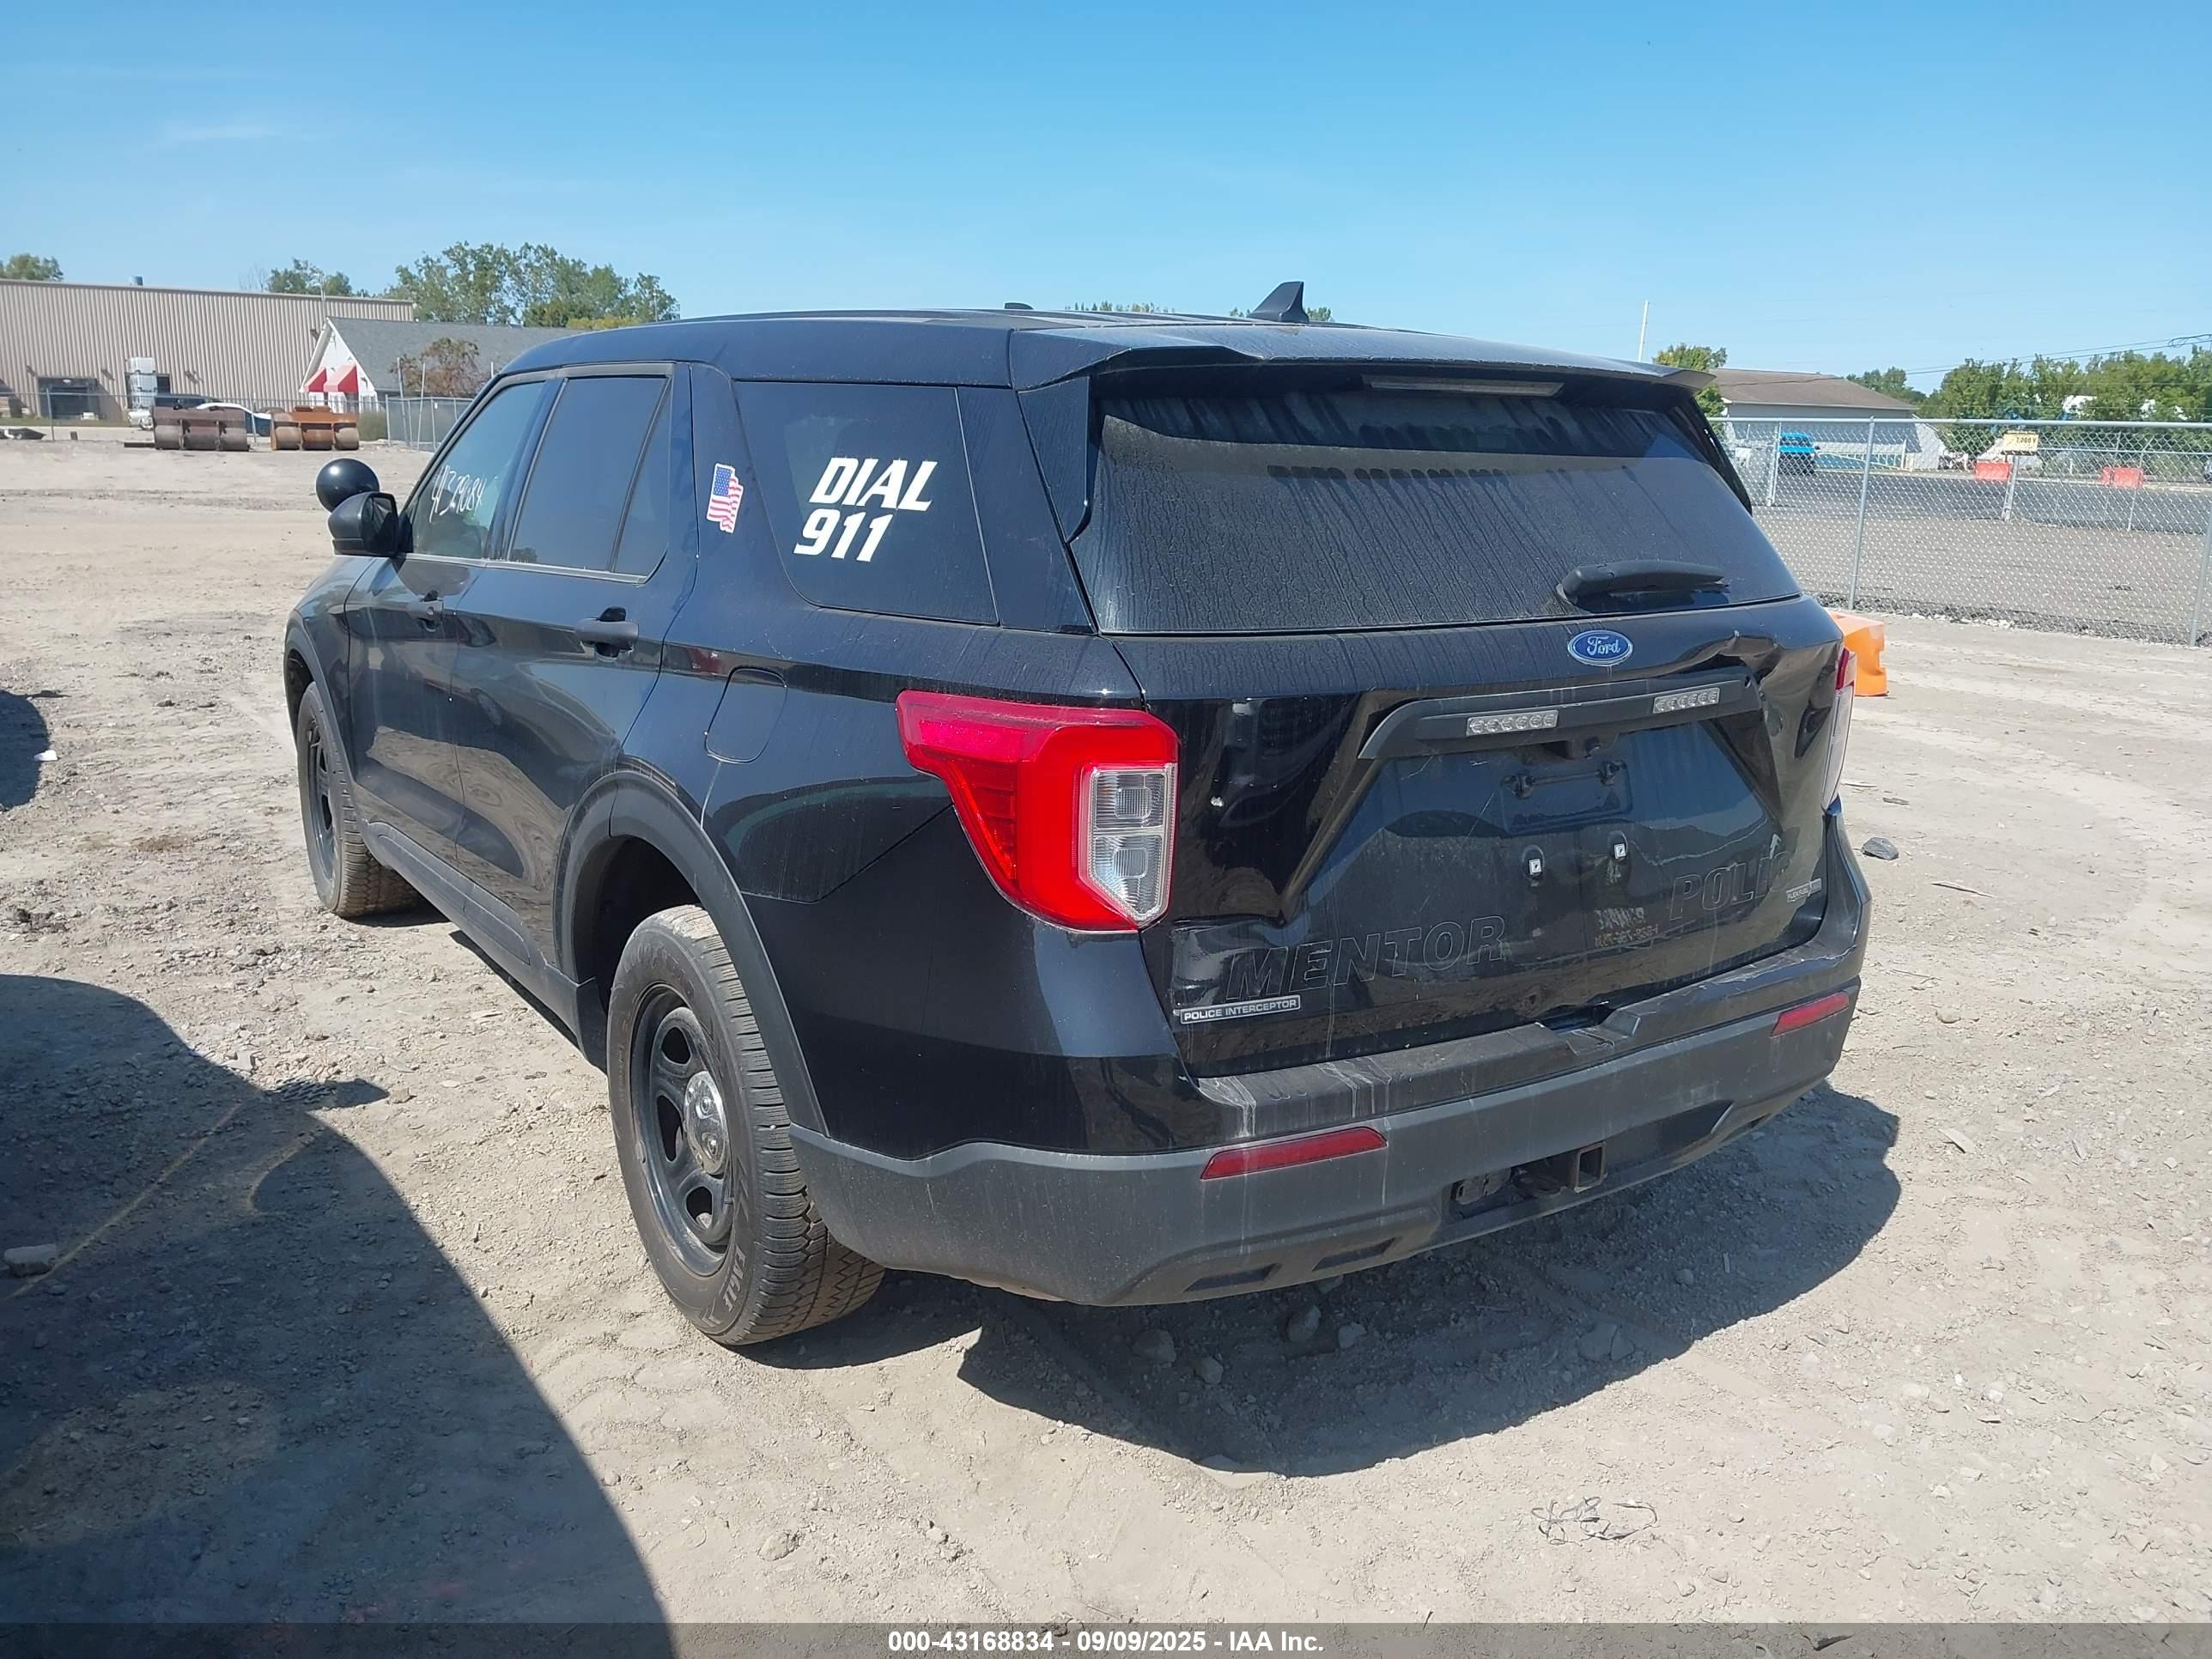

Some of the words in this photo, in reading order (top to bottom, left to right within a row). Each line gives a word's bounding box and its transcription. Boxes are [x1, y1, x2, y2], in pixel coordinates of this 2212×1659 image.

[809, 457, 938, 512] DIAL
[793, 507, 894, 562] 911
[1586, 635, 1622, 656] Ford
[1224, 915, 1506, 1003] MENTOR
[1183, 1008, 1223, 1022] POLICE
[1225, 999, 1297, 1017] INTERCEPTOR
[723, 1243, 746, 1312] EAGLE
